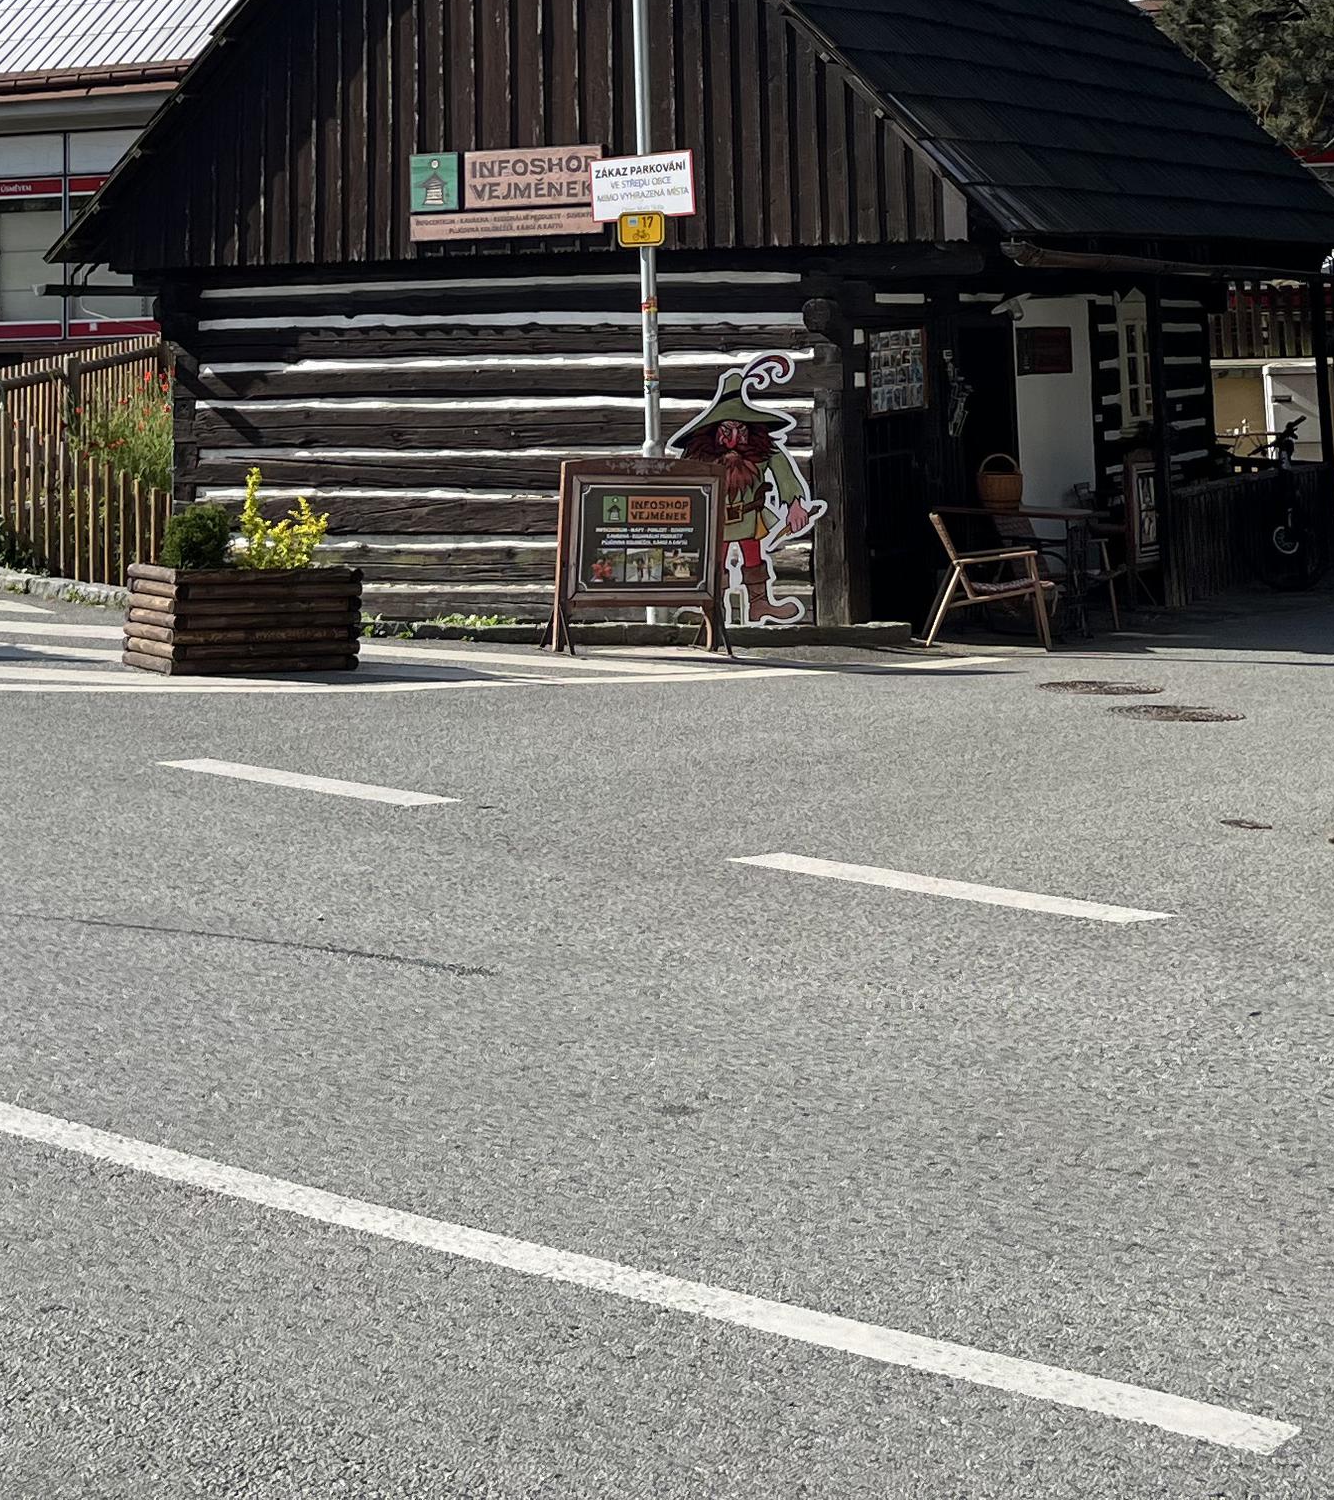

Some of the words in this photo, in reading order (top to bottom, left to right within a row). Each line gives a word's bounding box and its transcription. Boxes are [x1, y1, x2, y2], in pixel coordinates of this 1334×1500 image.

[595, 166, 628, 179] ZÁKAZ
[630, 159, 686, 175] PARKOVÁNÍ
[641, 216, 654, 229] 17
[630, 500, 689, 510] INFOSHOP
